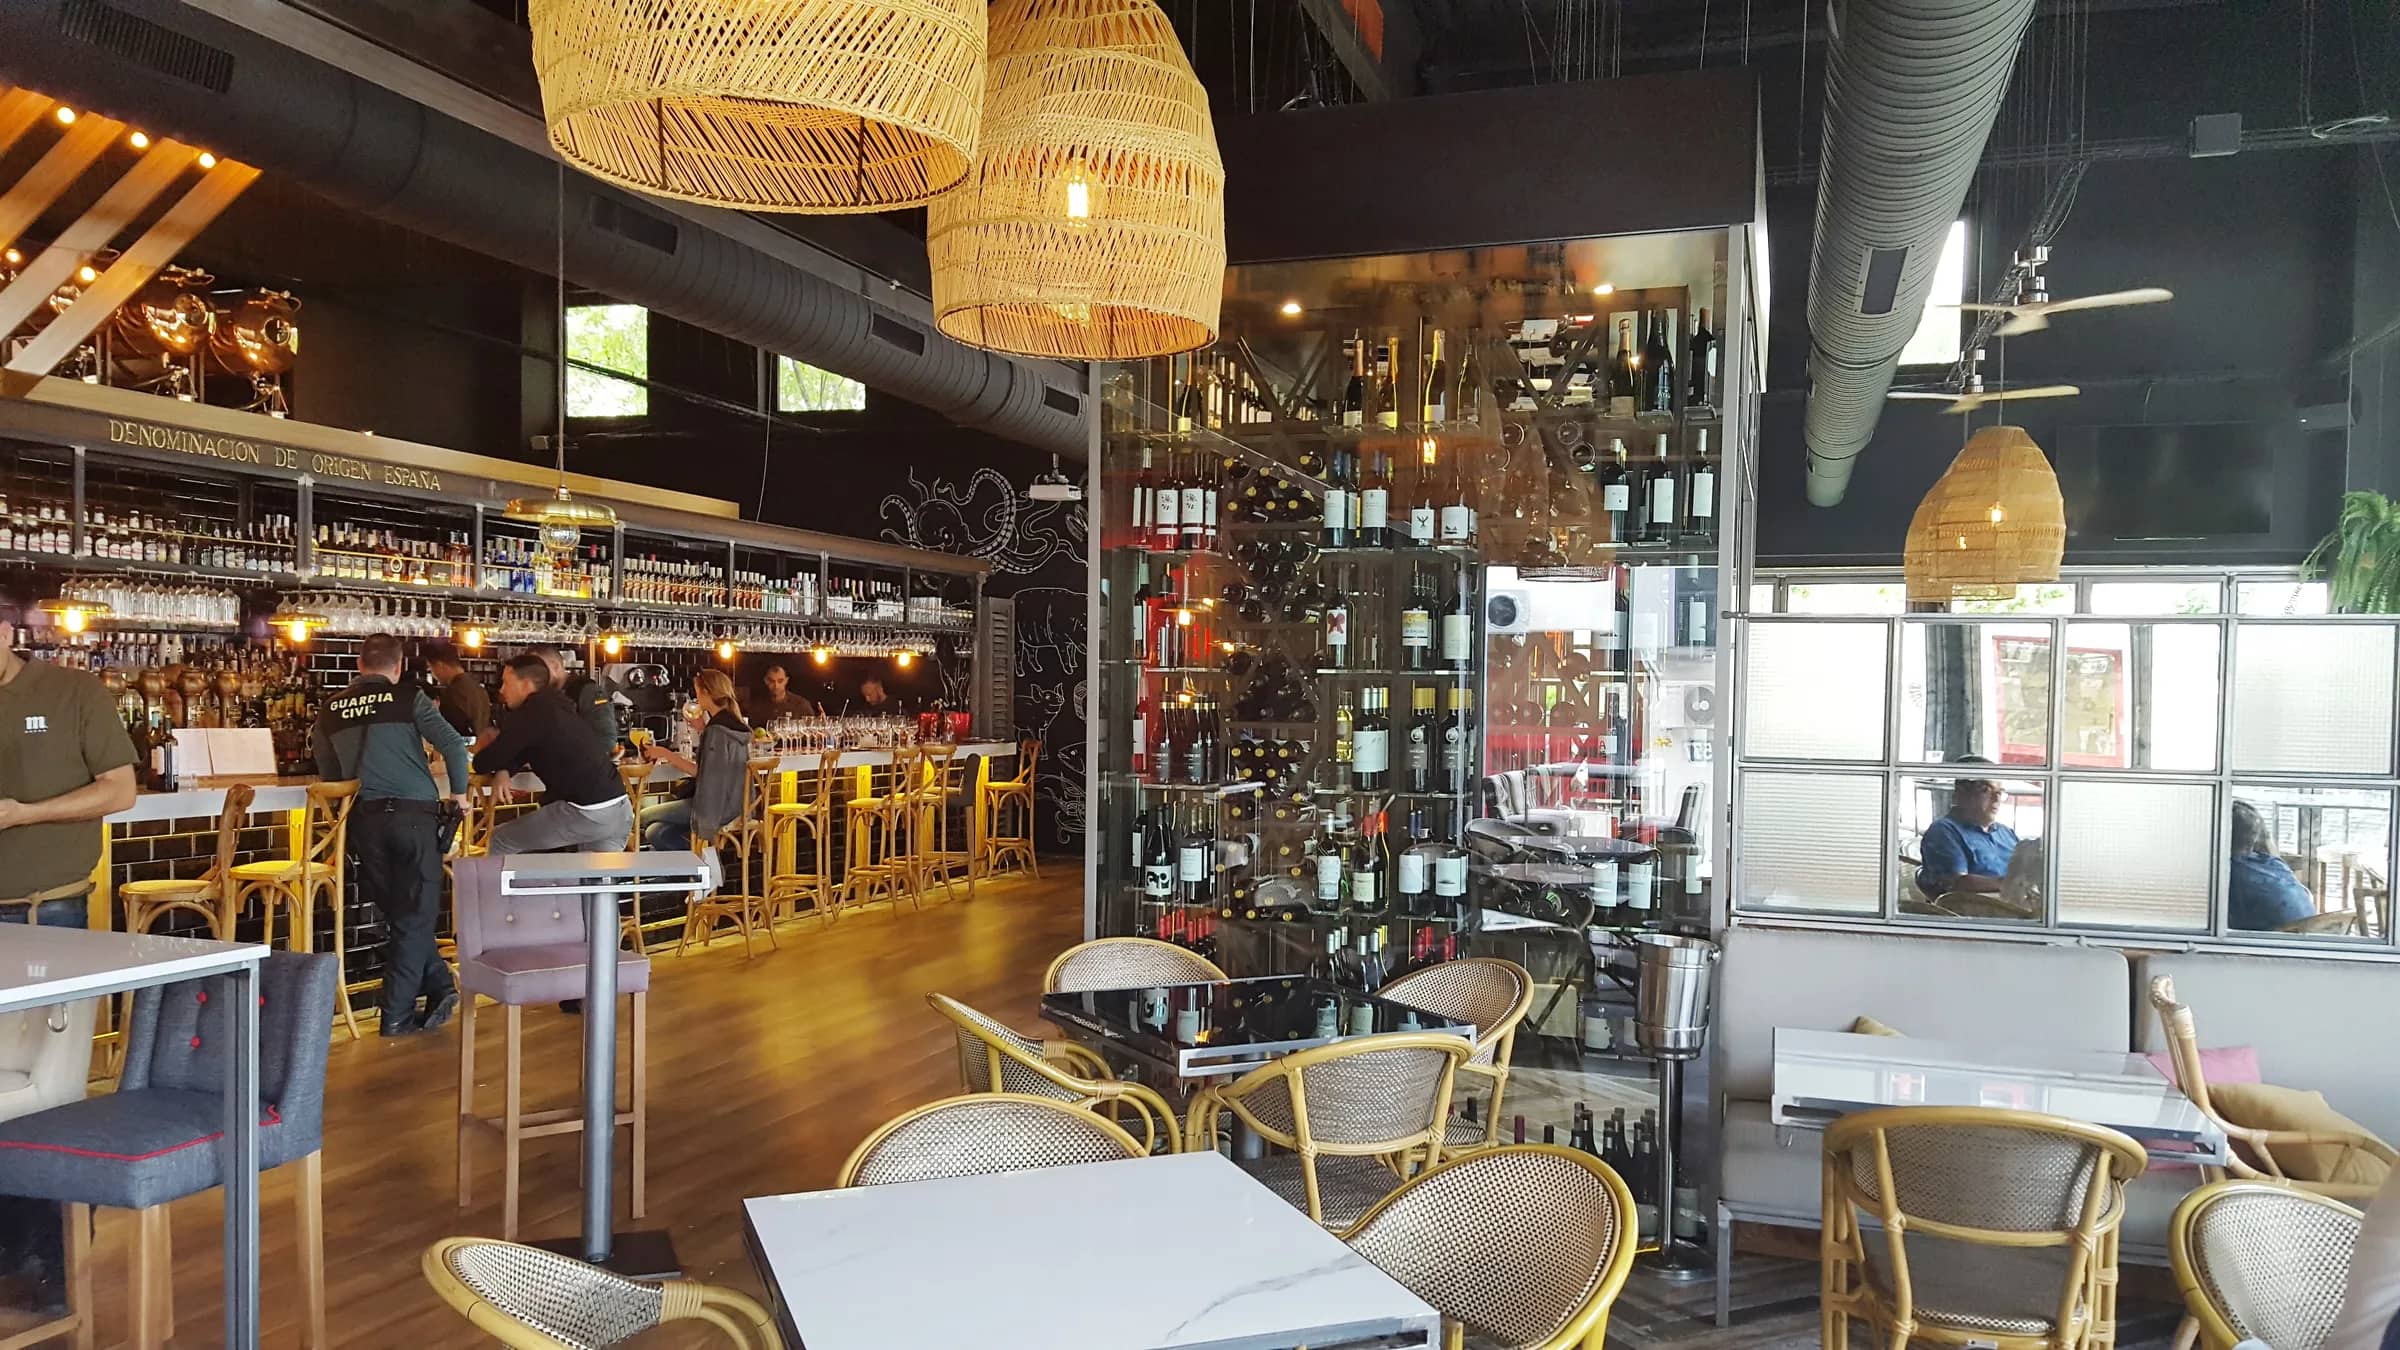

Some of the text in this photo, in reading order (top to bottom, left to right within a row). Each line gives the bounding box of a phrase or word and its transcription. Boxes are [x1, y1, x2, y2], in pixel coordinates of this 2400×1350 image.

[275, 447, 299, 470] DE
[384, 465, 441, 491] ESPAÑA
[330, 692, 394, 711] GUARDIA
